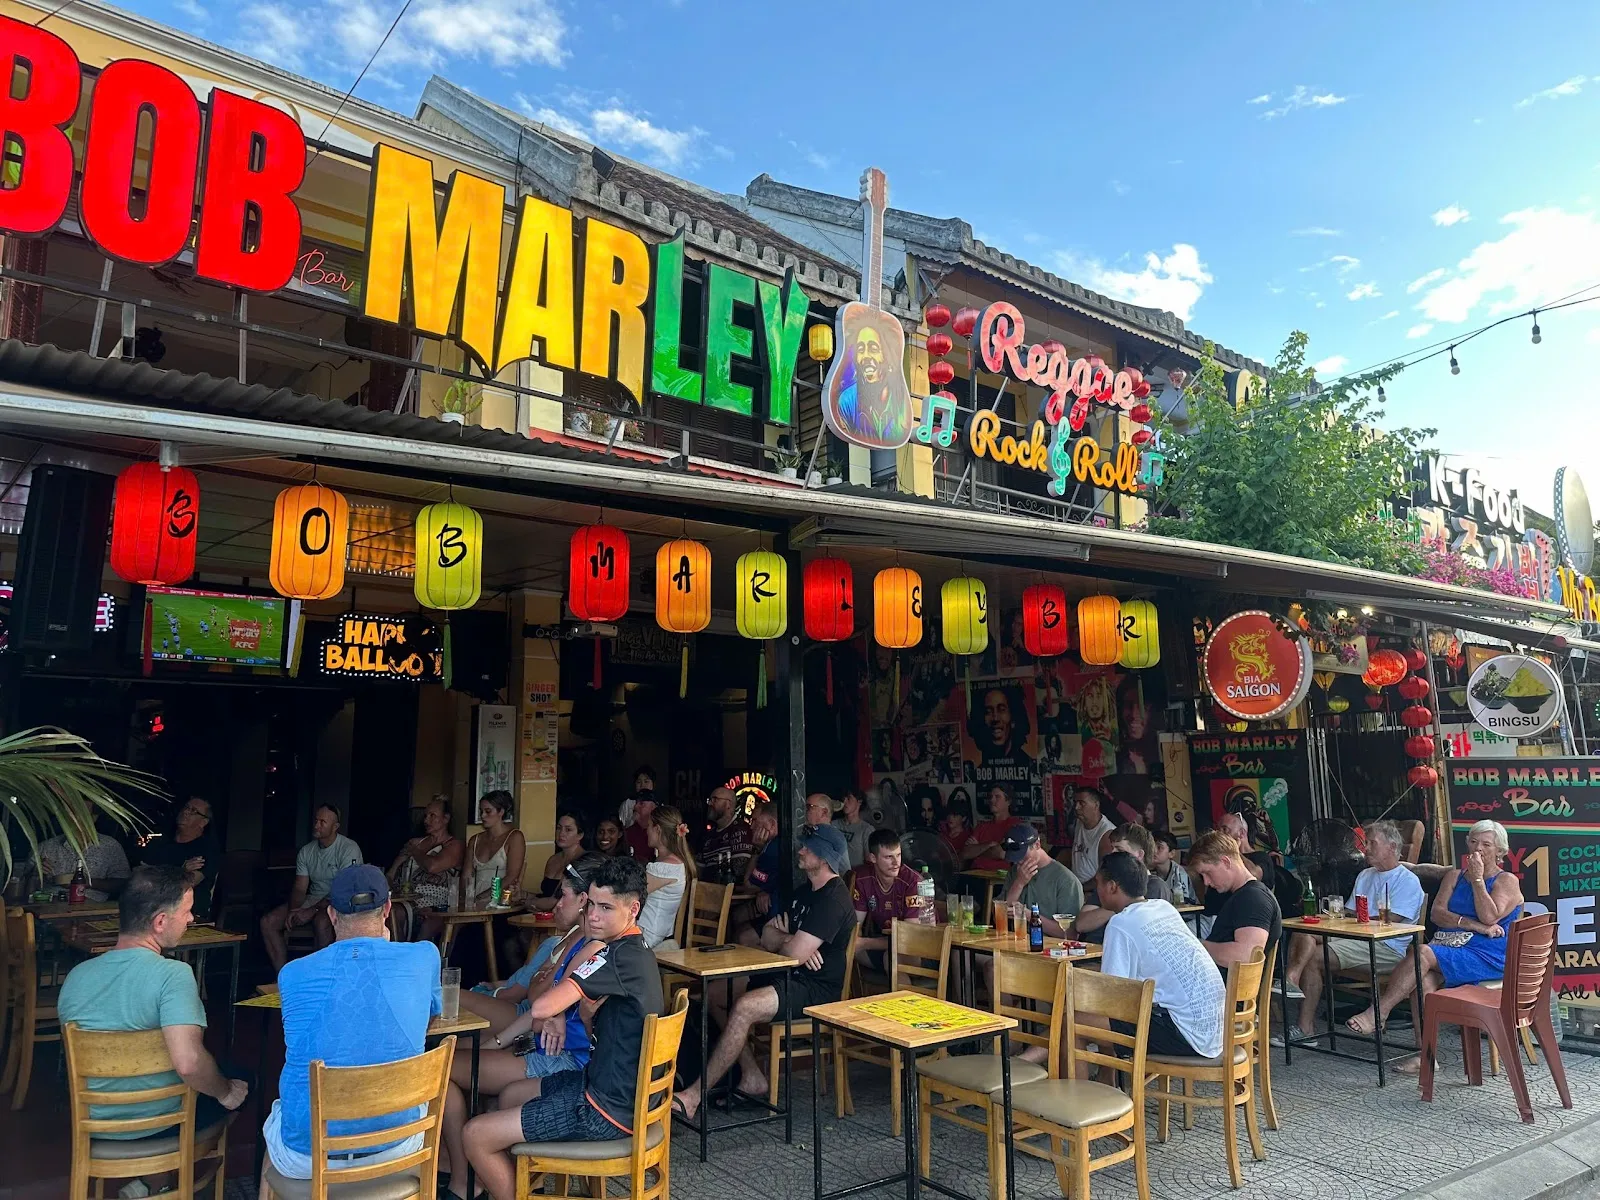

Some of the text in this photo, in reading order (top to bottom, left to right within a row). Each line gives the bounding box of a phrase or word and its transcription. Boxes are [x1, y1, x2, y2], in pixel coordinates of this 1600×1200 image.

[0, 14, 811, 427] BOB MARLEY
[299, 249, 354, 292] Bar
[973, 300, 1135, 432] Reggae
[966, 408, 1140, 493] Rock Roll
[525, 682, 556, 694] GINGER
[1243, 675, 1261, 684] BIA
[530, 693, 551, 703] SHOT
[1226, 683, 1281, 699] SAIGON
[1488, 716, 1541, 727] BINGSU
[1192, 735, 1299, 753] BOB MARLEY
[976, 766, 1029, 781] BOB MARLEY
[1222, 752, 1267, 776] Bar
[742, 771, 777, 793] MARLEY
[1453, 767, 1600, 788] BOB MARLE
[1503, 788, 1576, 818] Bar
